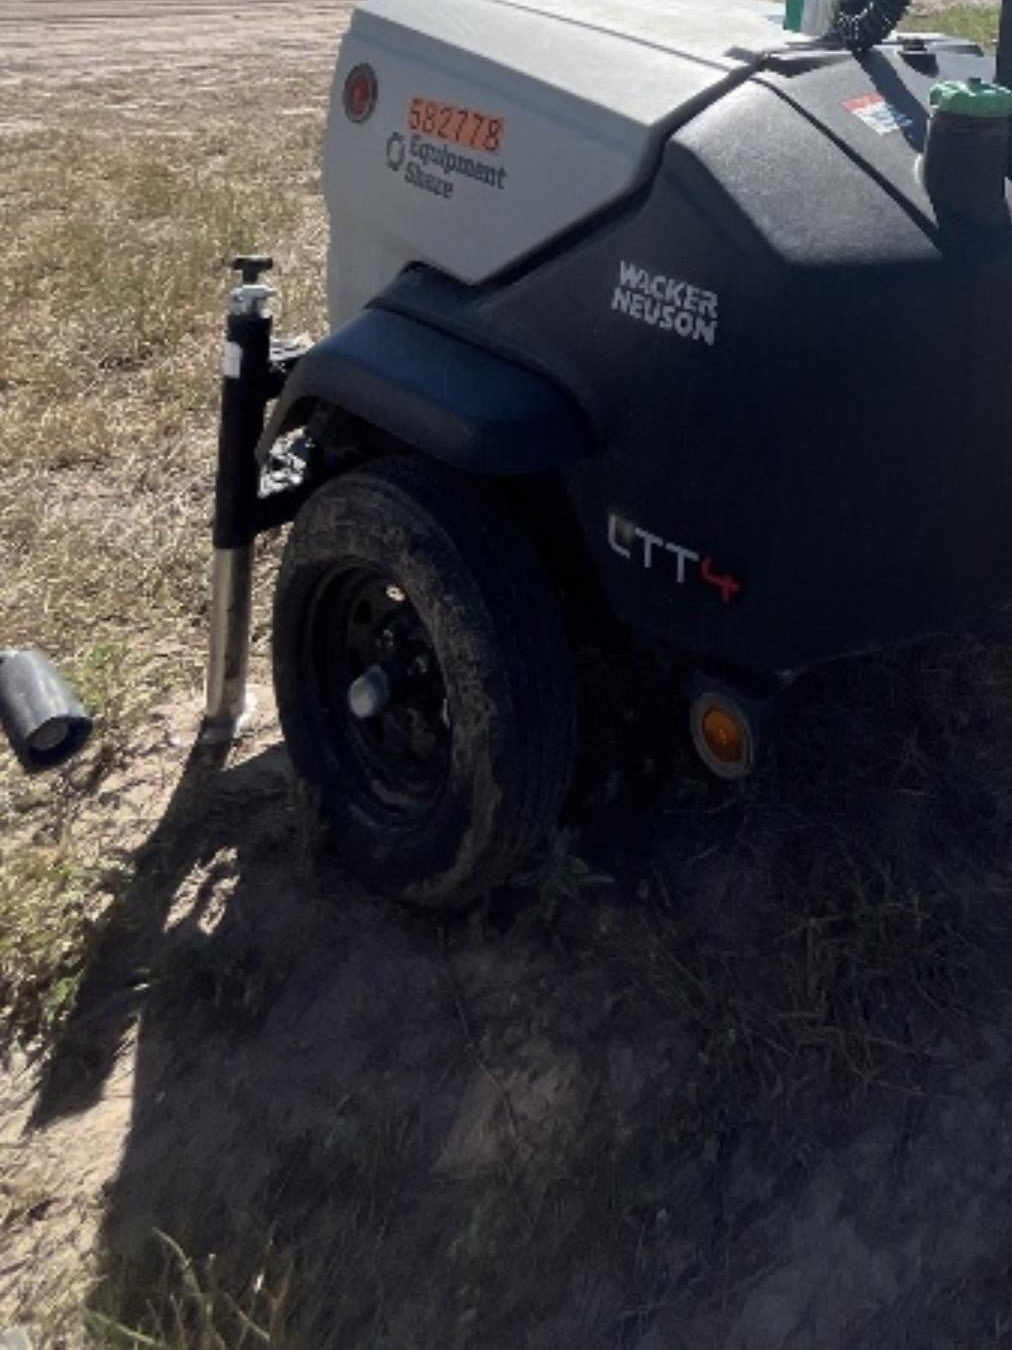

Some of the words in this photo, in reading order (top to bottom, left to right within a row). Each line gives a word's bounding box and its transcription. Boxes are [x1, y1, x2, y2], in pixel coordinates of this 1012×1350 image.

[407, 97, 503, 152] 582778
[404, 160, 454, 199] Share
[409, 134, 508, 190] Equipment
[611, 287, 718, 346] NEUSON
[620, 260, 718, 319] WACKER
[607, 513, 740, 603] LTT4
